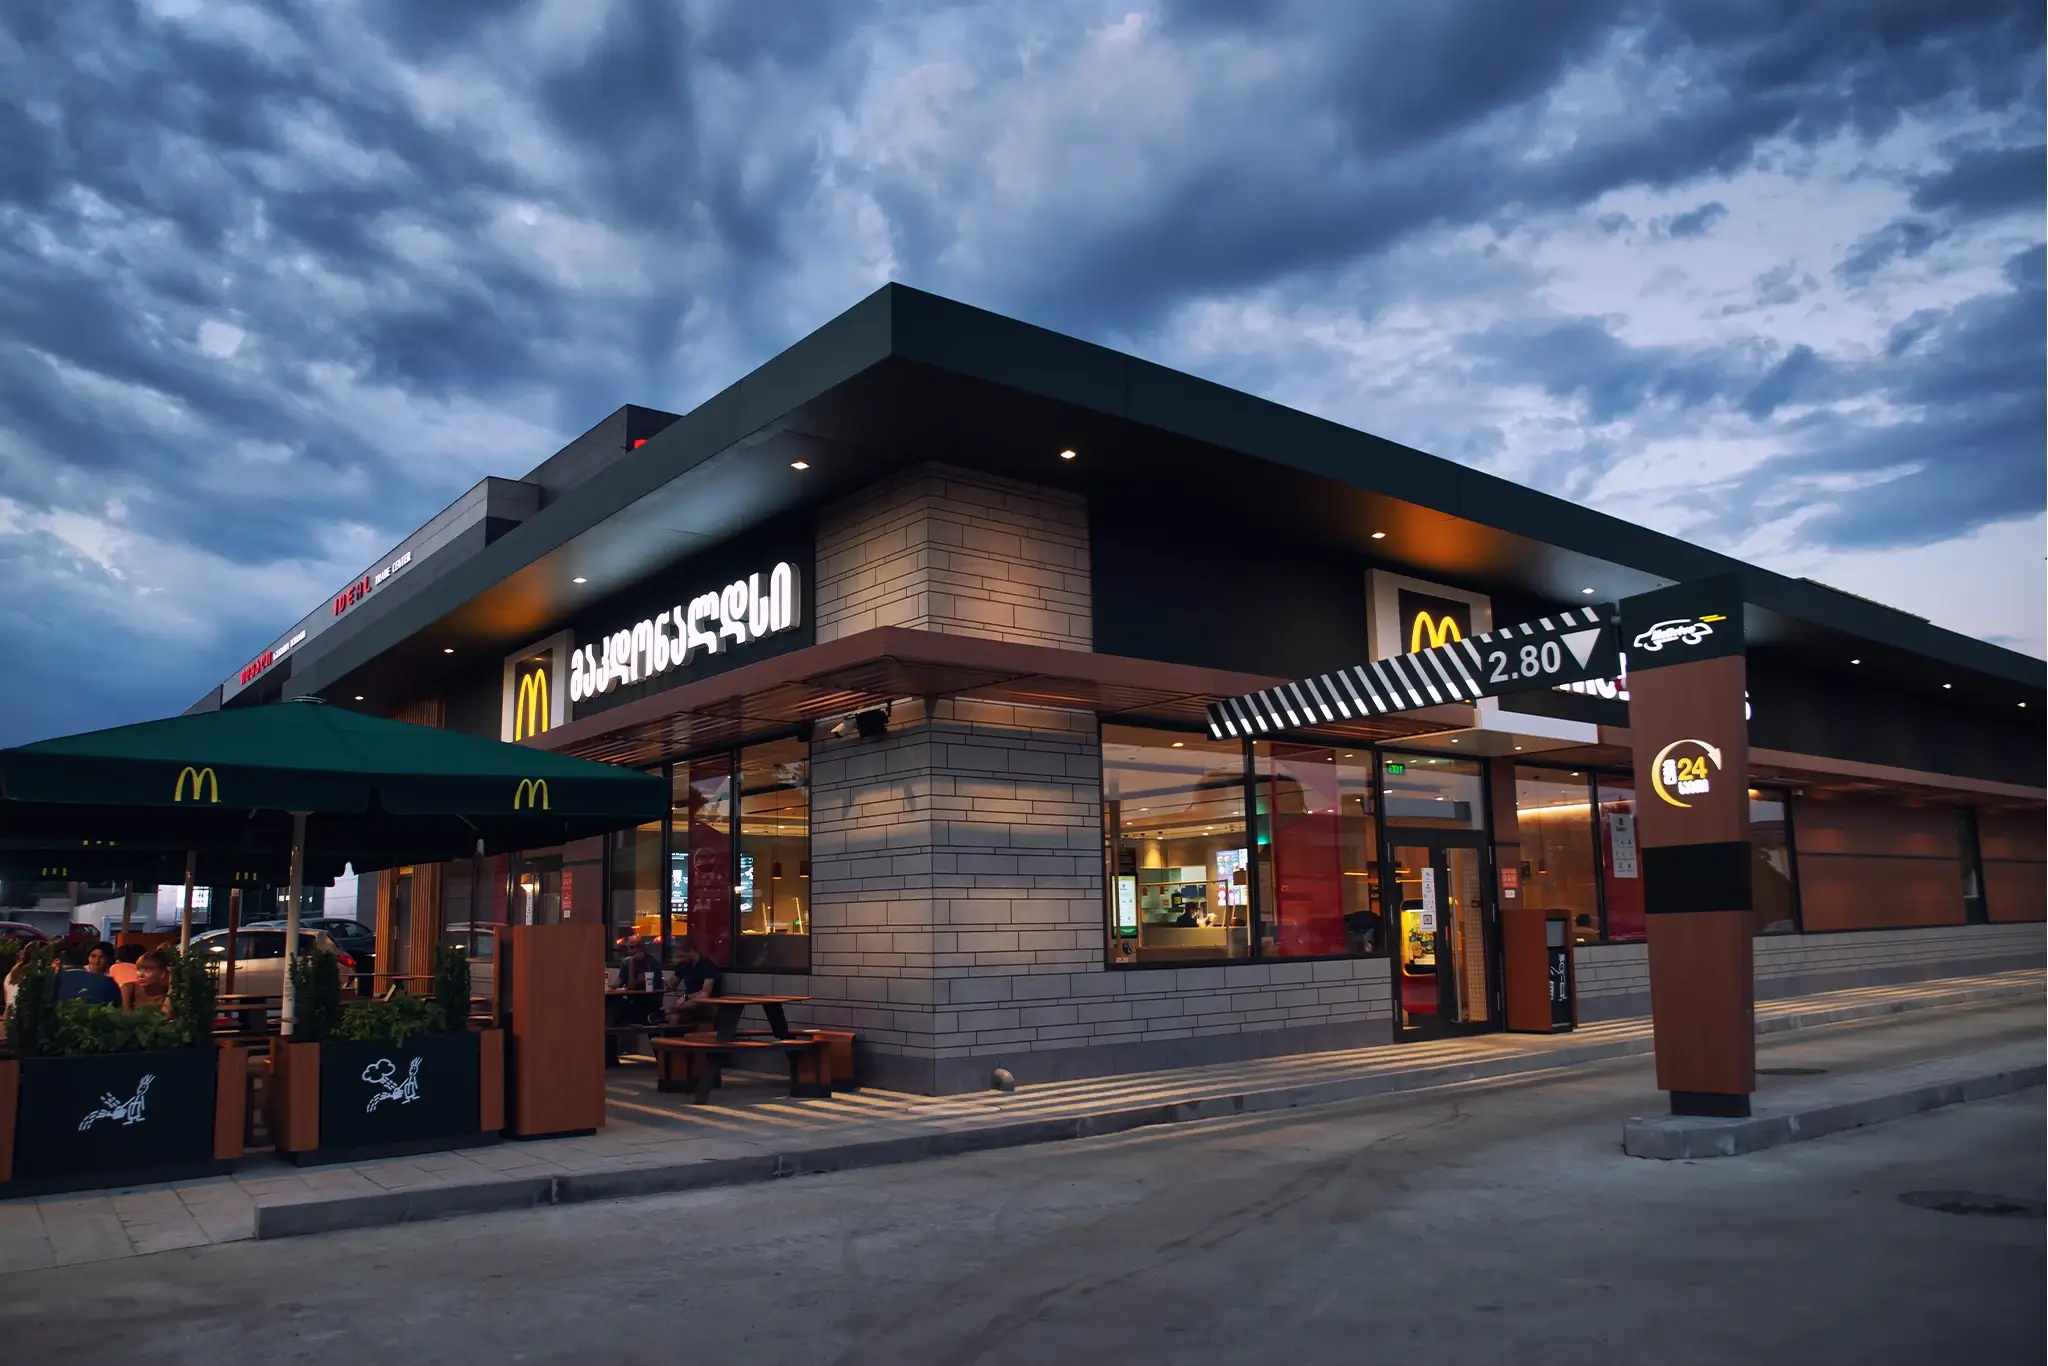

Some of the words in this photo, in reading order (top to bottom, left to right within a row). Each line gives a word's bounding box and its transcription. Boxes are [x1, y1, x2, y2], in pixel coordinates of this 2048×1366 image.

[333, 576, 372, 616] IDEAL
[570, 561, 795, 702] მაკდონალდსი
[1489, 641, 1561, 683] 2.80
[1678, 756, 1707, 781] 24
